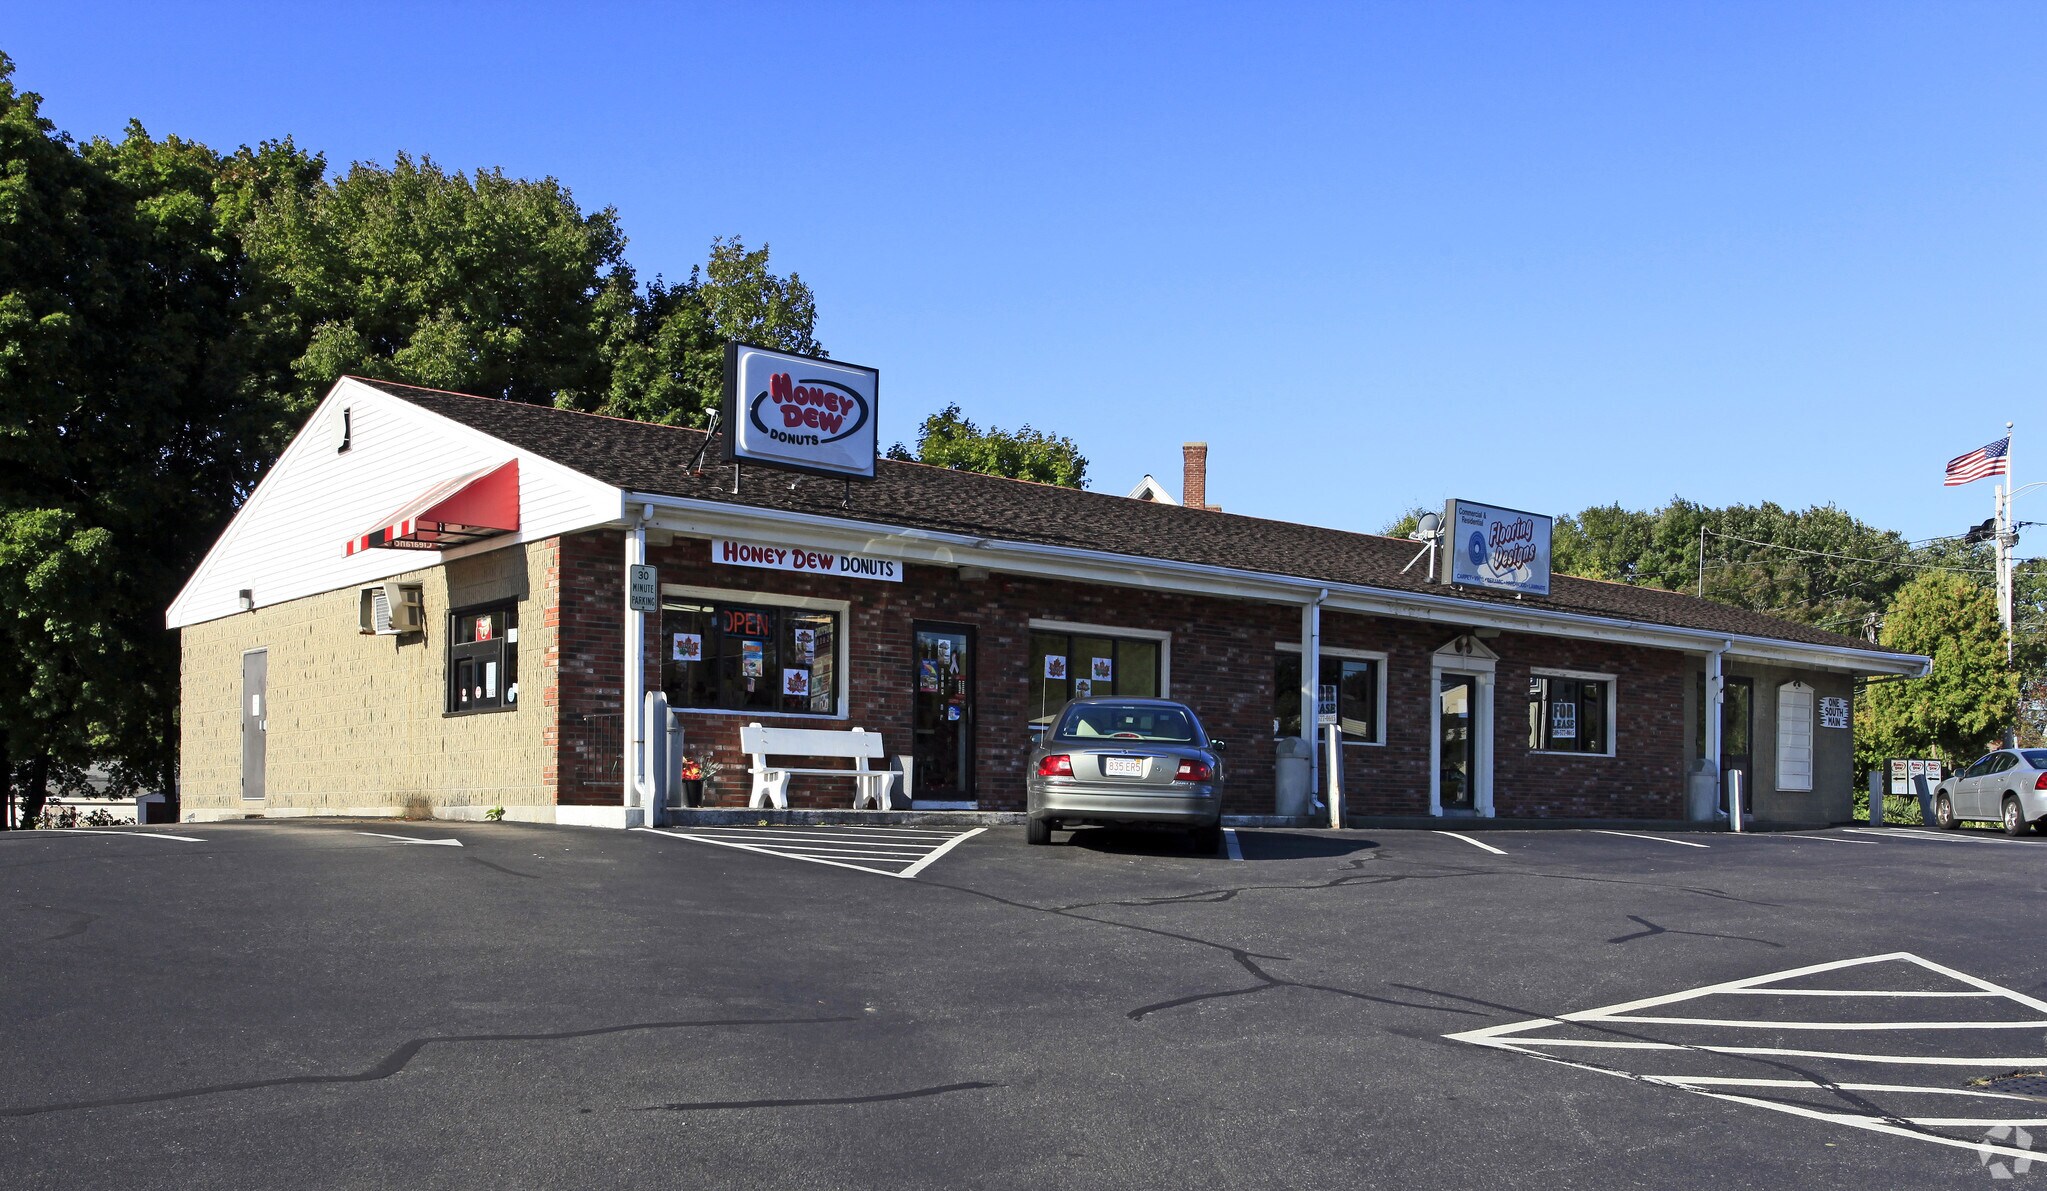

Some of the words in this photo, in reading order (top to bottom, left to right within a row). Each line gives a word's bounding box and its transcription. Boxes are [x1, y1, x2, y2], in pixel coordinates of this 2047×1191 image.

[770, 372, 854, 416] HONEY
[780, 404, 844, 434] DEW
[770, 428, 819, 445] DONUTS
[1489, 517, 1533, 548] Flooring
[723, 540, 787, 565] HONEY
[792, 548, 834, 570] DEW
[840, 556, 894, 577] DONUTS
[1494, 543, 1536, 570] Designs
[638, 570, 649, 580] 30
[632, 583, 654, 593] MINUTE
[631, 595, 655, 606] PARKING
[1318, 685, 1335, 702] OR
[1828, 698, 1840, 707] ONE
[1553, 703, 1574, 719] FOR
[1825, 706, 1844, 717] SOUTH
[1552, 719, 1575, 729] LEASE
[1828, 716, 1841, 727] MAIN
